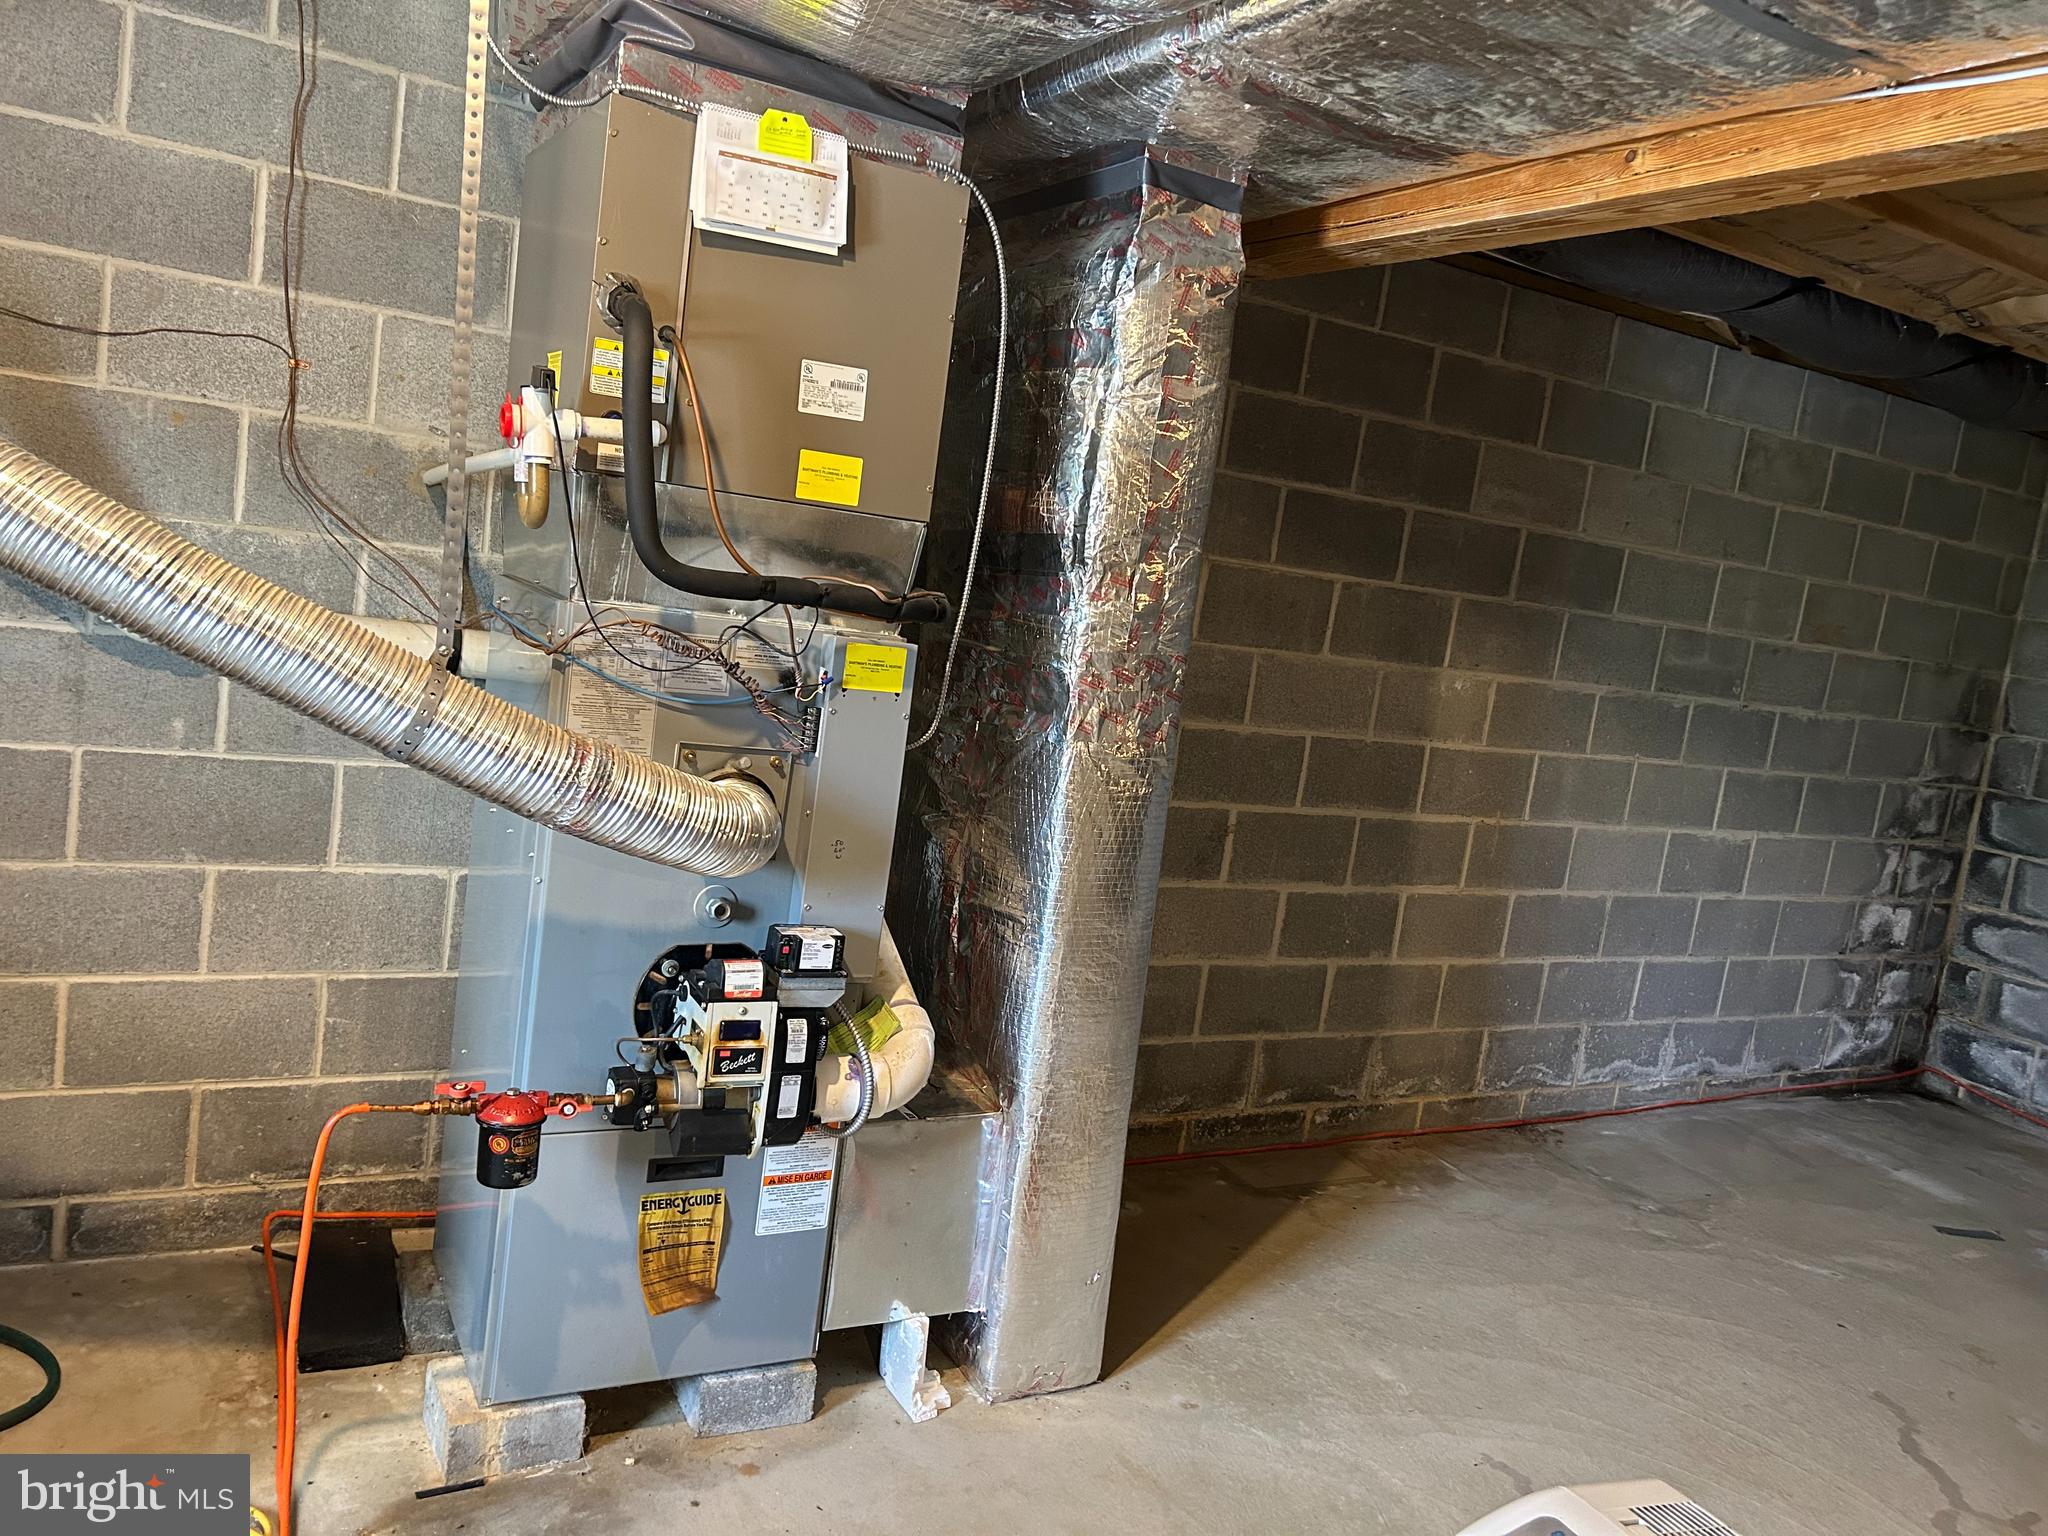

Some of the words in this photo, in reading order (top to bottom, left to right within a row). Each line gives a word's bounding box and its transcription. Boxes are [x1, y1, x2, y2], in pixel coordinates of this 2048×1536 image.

[720, 1052, 756, 1072] Beckett
[777, 1175, 793, 1184] MISE
[794, 1174, 804, 1182] EN
[804, 1172, 827, 1181] GARDE
[641, 1193, 722, 1214] ENERGYGUIDE
